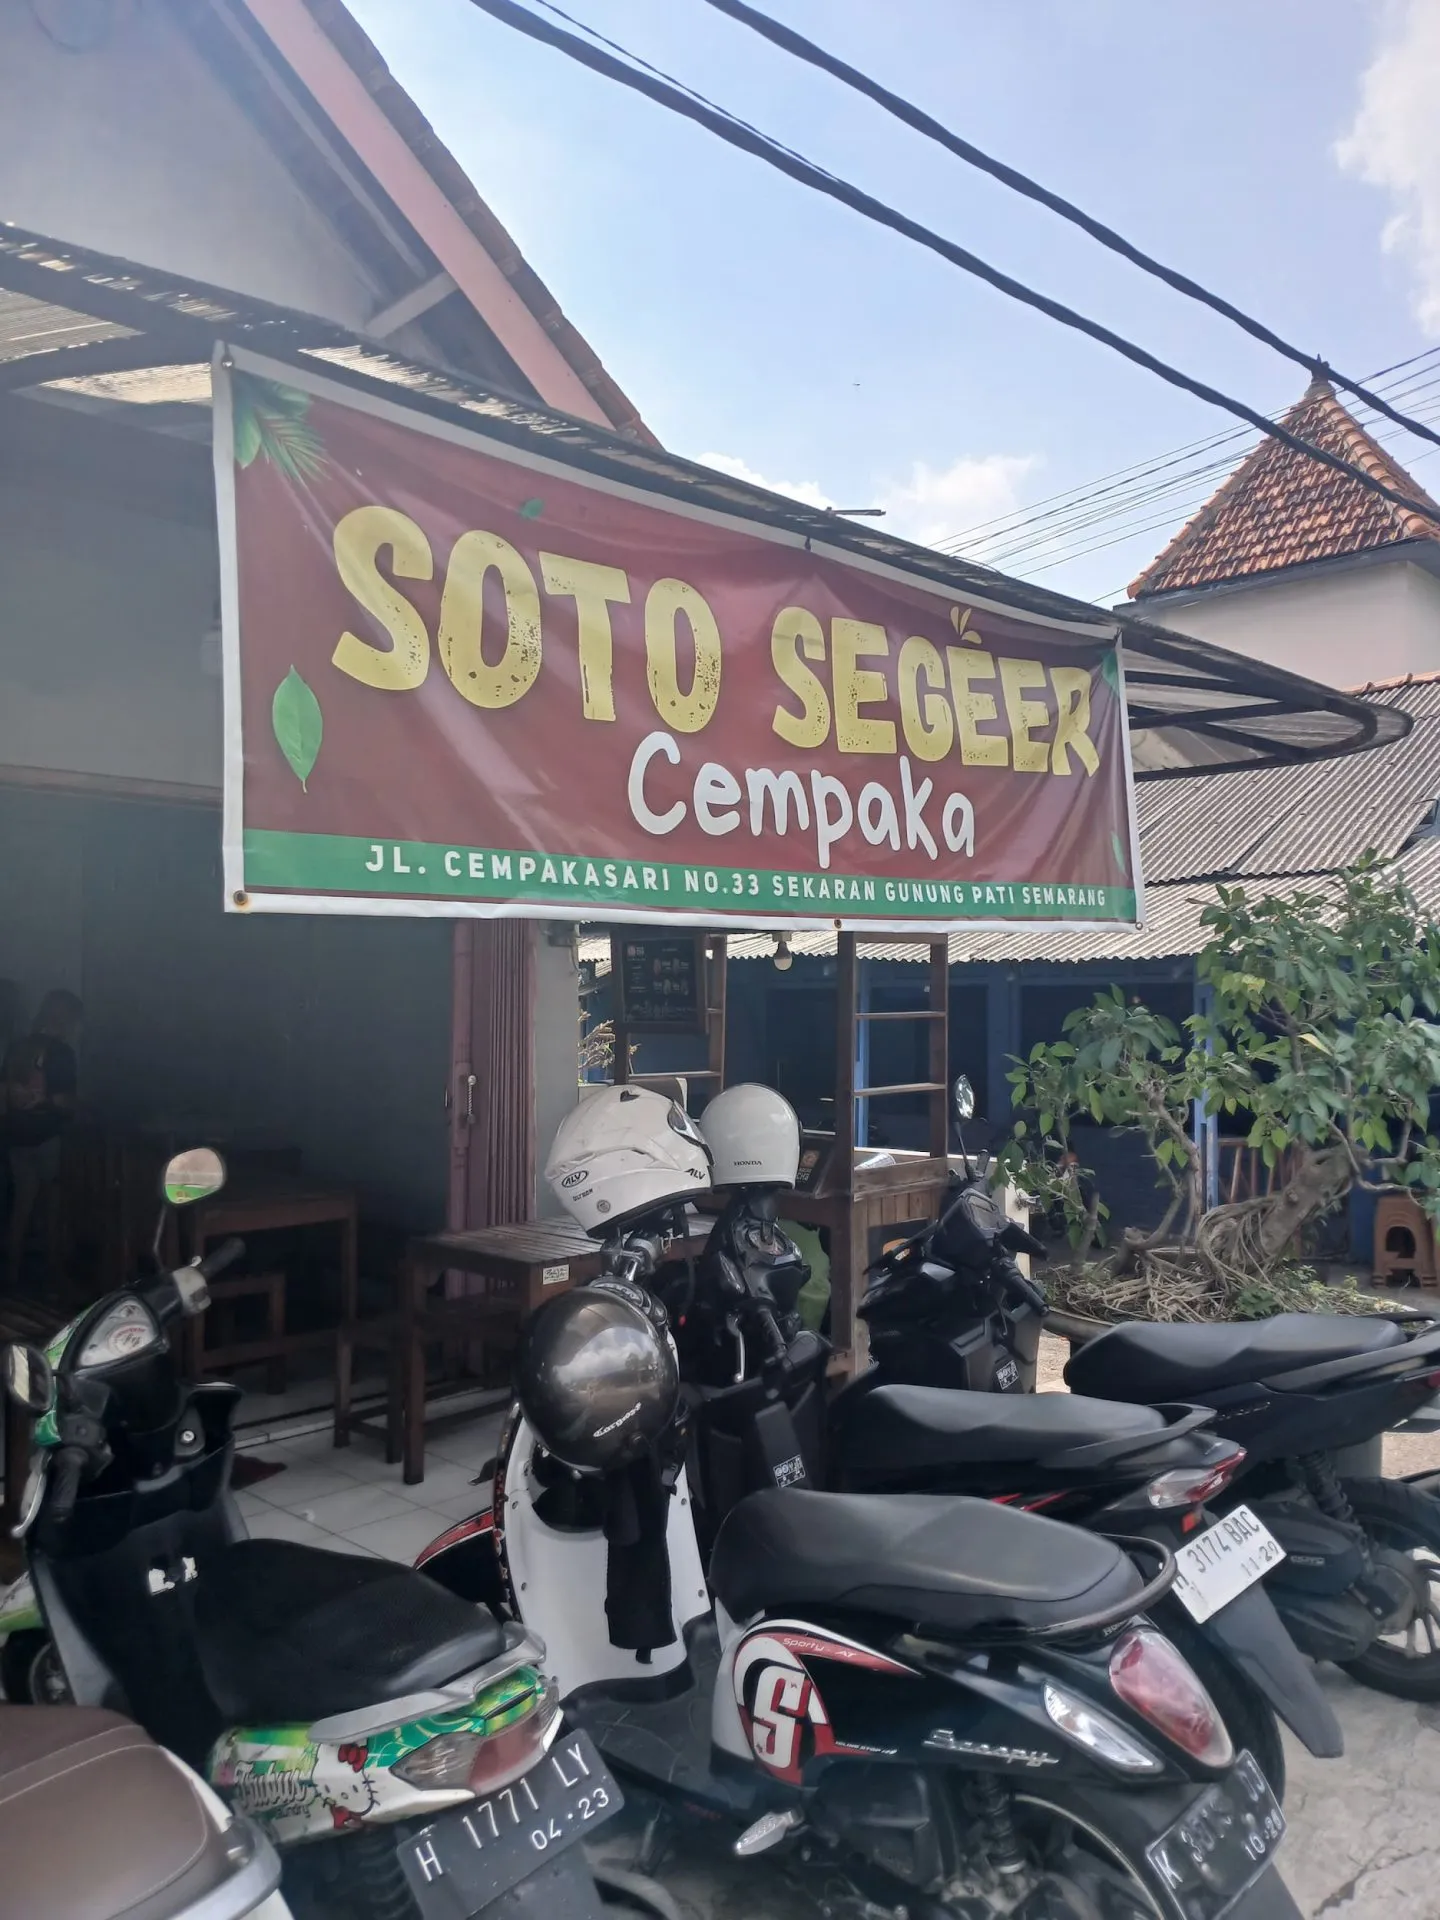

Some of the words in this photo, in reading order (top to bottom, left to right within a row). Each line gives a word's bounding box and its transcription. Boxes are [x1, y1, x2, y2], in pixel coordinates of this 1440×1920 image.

[331, 505, 722, 733] SOTO
[770, 606, 1100, 777] SEGEER
[627, 730, 976, 869] Cempaka
[365, 844, 427, 875] JL.
[444, 850, 670, 892] CEMPAKASARI
[684, 869, 760, 896] NO.33
[772, 874, 876, 901] SEKARAN
[885, 882, 964, 905] GUNUNG
[972, 886, 1015, 905] PATI
[1022, 886, 1106, 907] SEMARANG
[1186, 1530, 1233, 1574] 3174
[1221, 1510, 1261, 1546] BAC
[782, 1637, 826, 1651] Sporty
[414, 1840, 444, 1882] H
[461, 1777, 540, 1850] 1771
[552, 1742, 591, 1788] LY
